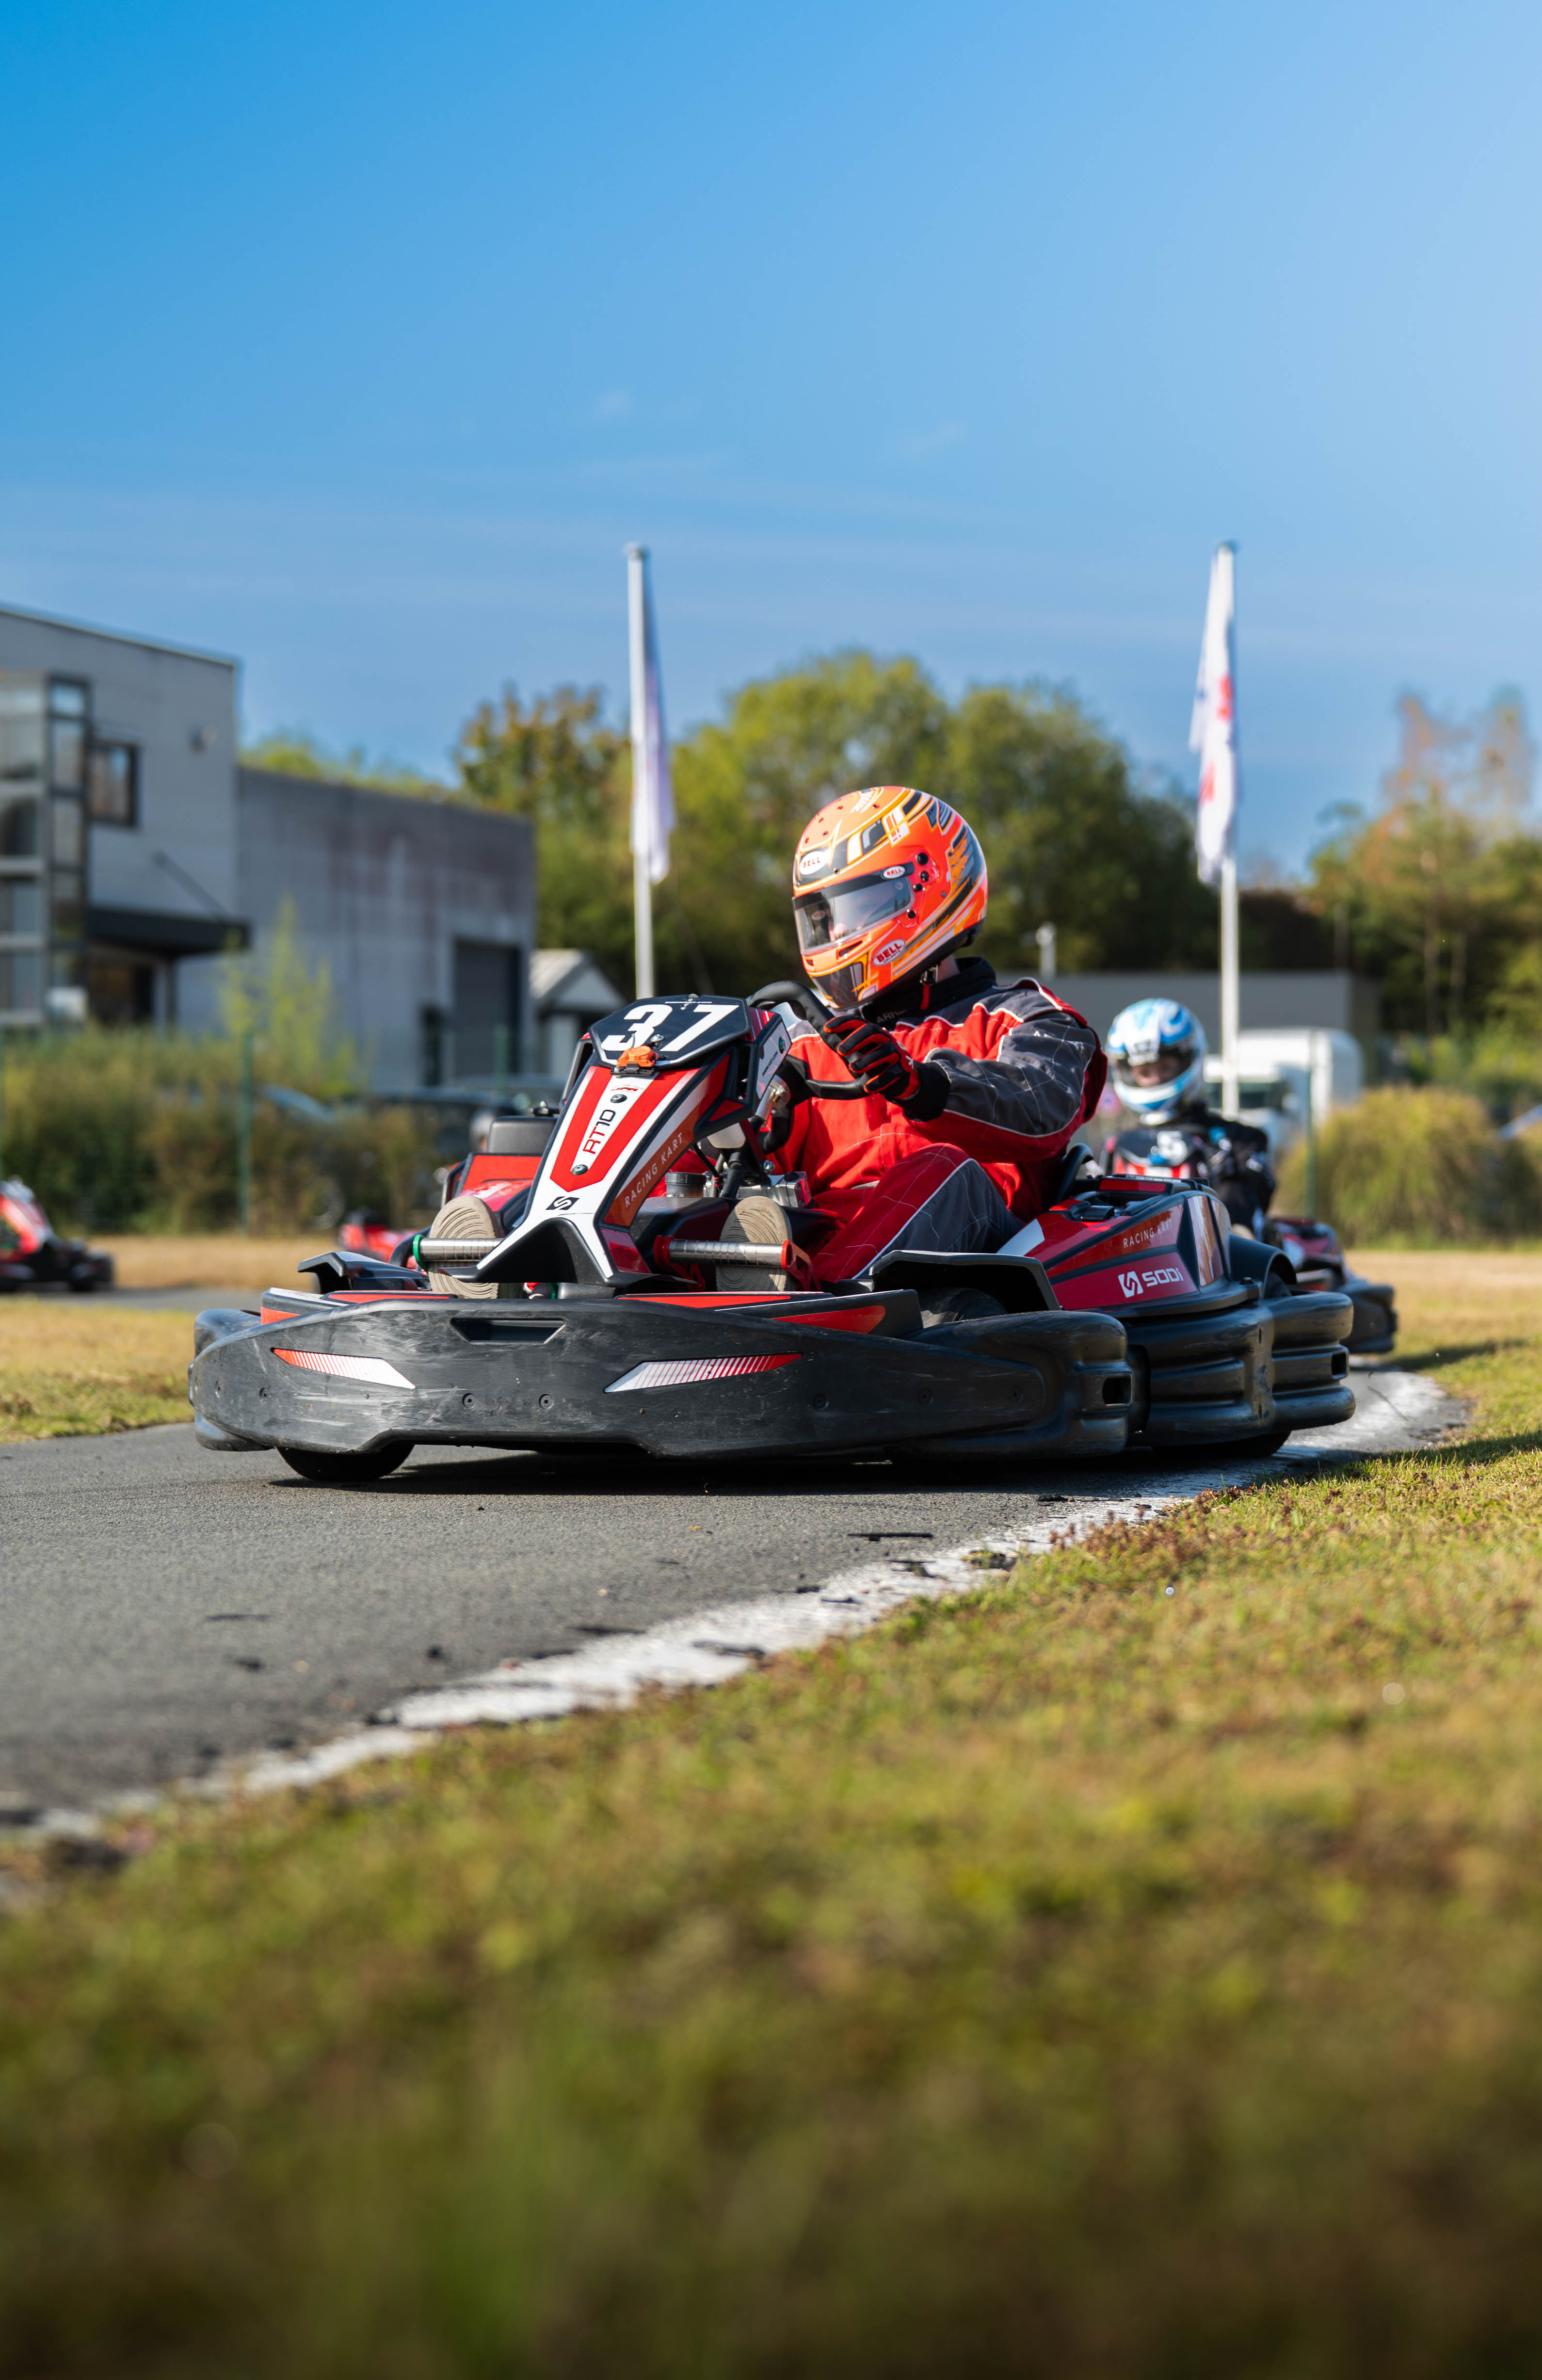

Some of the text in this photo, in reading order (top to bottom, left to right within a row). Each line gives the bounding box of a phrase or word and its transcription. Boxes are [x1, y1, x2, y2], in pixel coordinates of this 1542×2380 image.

[803, 857, 821, 868] BELL
[876, 943, 902, 963] BELL
[601, 1004, 739, 1051] 37
[582, 1109, 616, 1154] RT10
[625, 1132, 683, 1208] RACING KART
[1123, 1219, 1173, 1249] RACING KART
